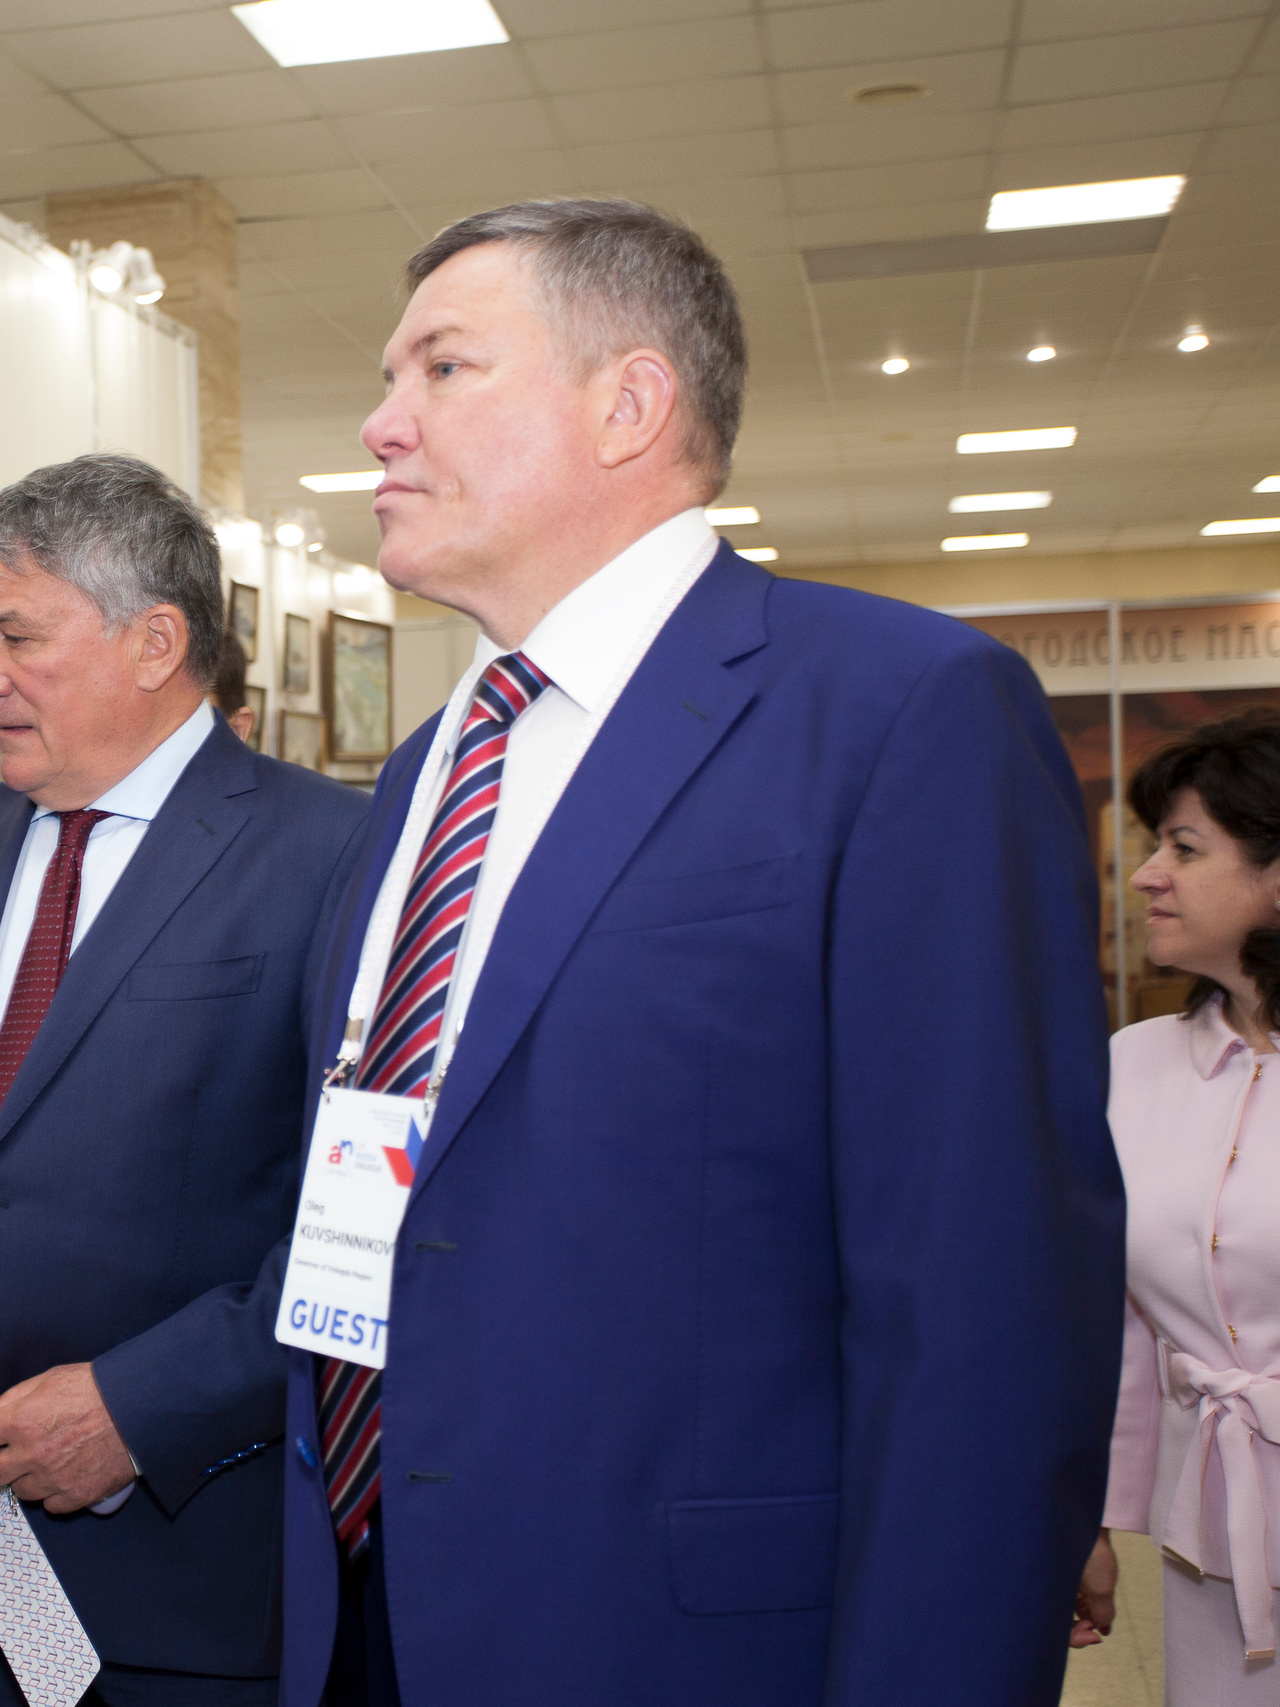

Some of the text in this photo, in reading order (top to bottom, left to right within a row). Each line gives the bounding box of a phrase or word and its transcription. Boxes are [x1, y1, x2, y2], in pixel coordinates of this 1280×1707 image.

[304, 1199, 325, 1217] Oleg
[299, 1224, 394, 1256] KUVSHINNIKOV
[290, 1299, 388, 1350] GUEST
